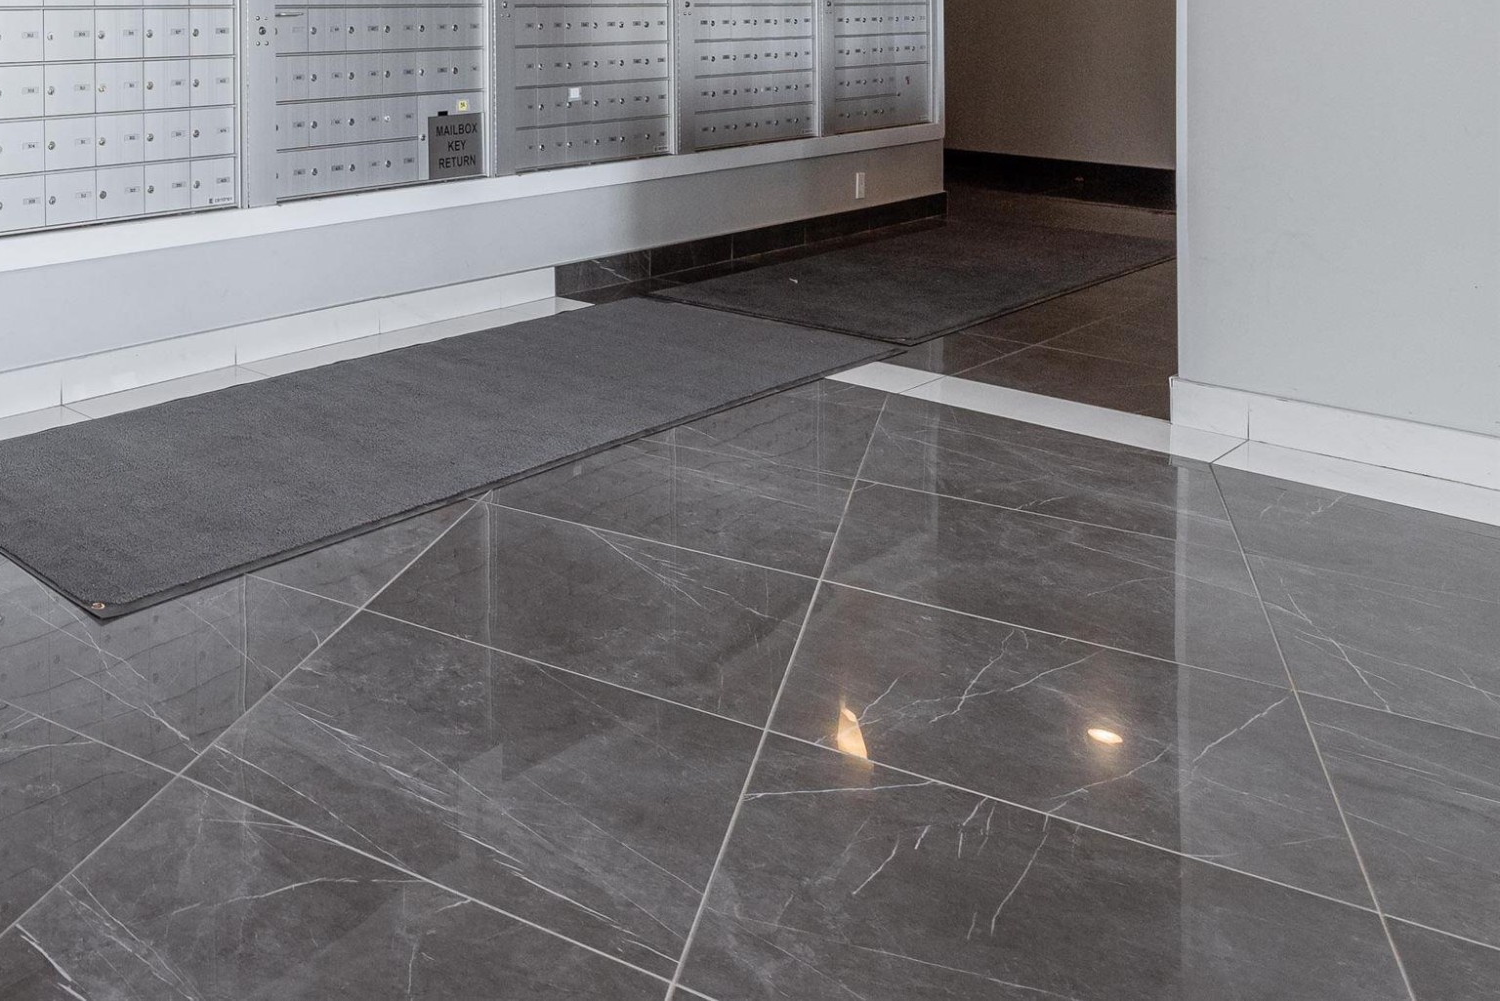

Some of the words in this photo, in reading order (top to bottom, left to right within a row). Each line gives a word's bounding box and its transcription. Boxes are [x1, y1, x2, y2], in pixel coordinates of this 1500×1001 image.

[436, 123, 478, 136] MAILBOX
[447, 140, 467, 152] KEY
[438, 155, 476, 169] RETURN
